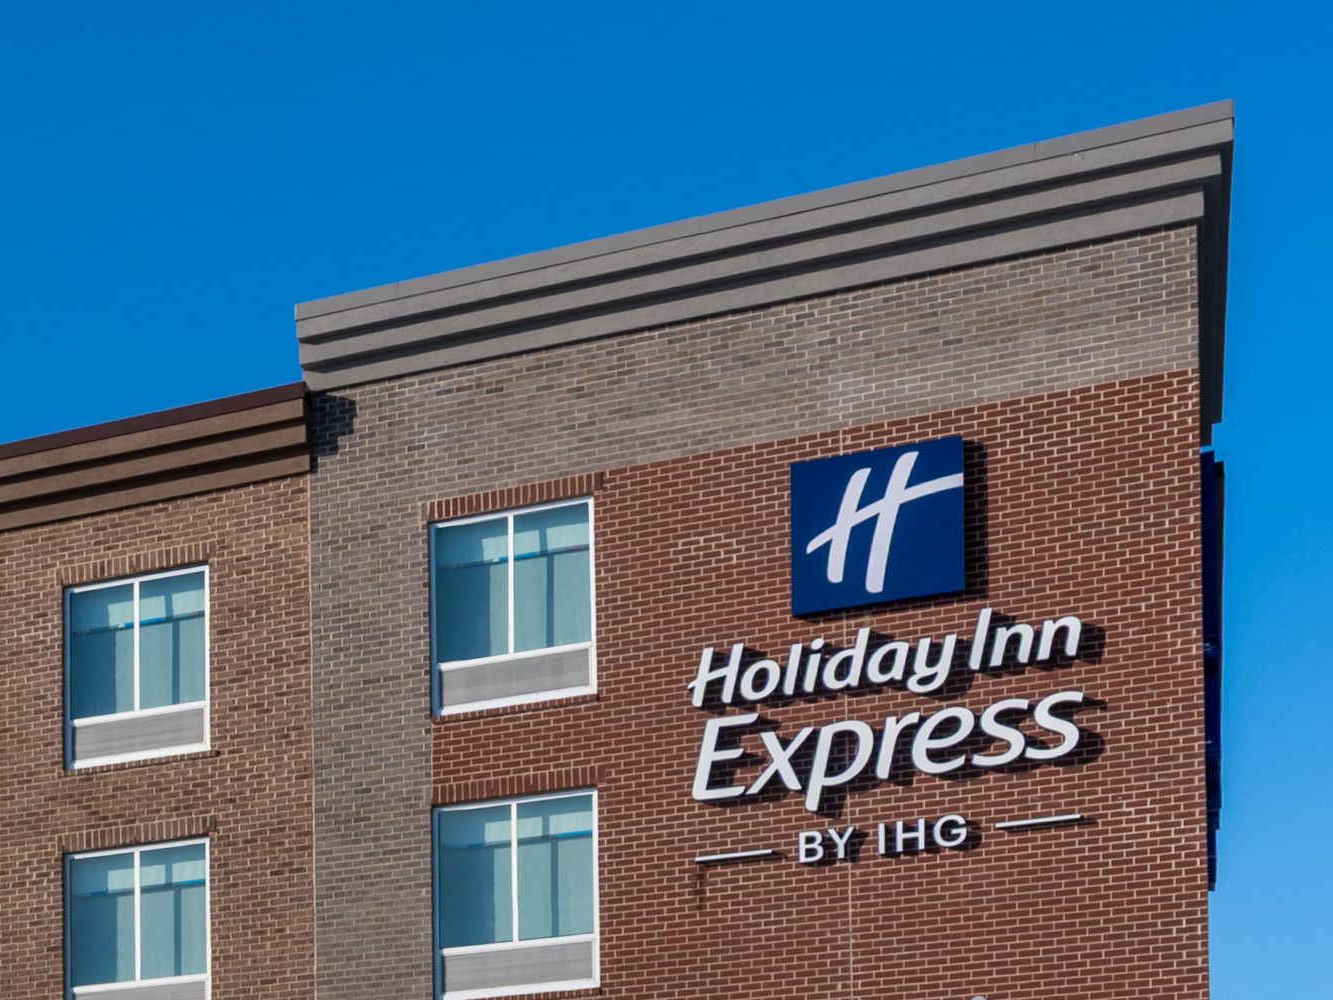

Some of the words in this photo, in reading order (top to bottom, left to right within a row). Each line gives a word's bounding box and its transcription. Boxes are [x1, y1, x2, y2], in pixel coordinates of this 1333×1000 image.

[688, 628, 958, 708] Holiday
[969, 607, 1082, 670] Inn
[692, 691, 1084, 812] Express
[798, 825, 855, 863] BY
[877, 814, 968, 855] IHG
